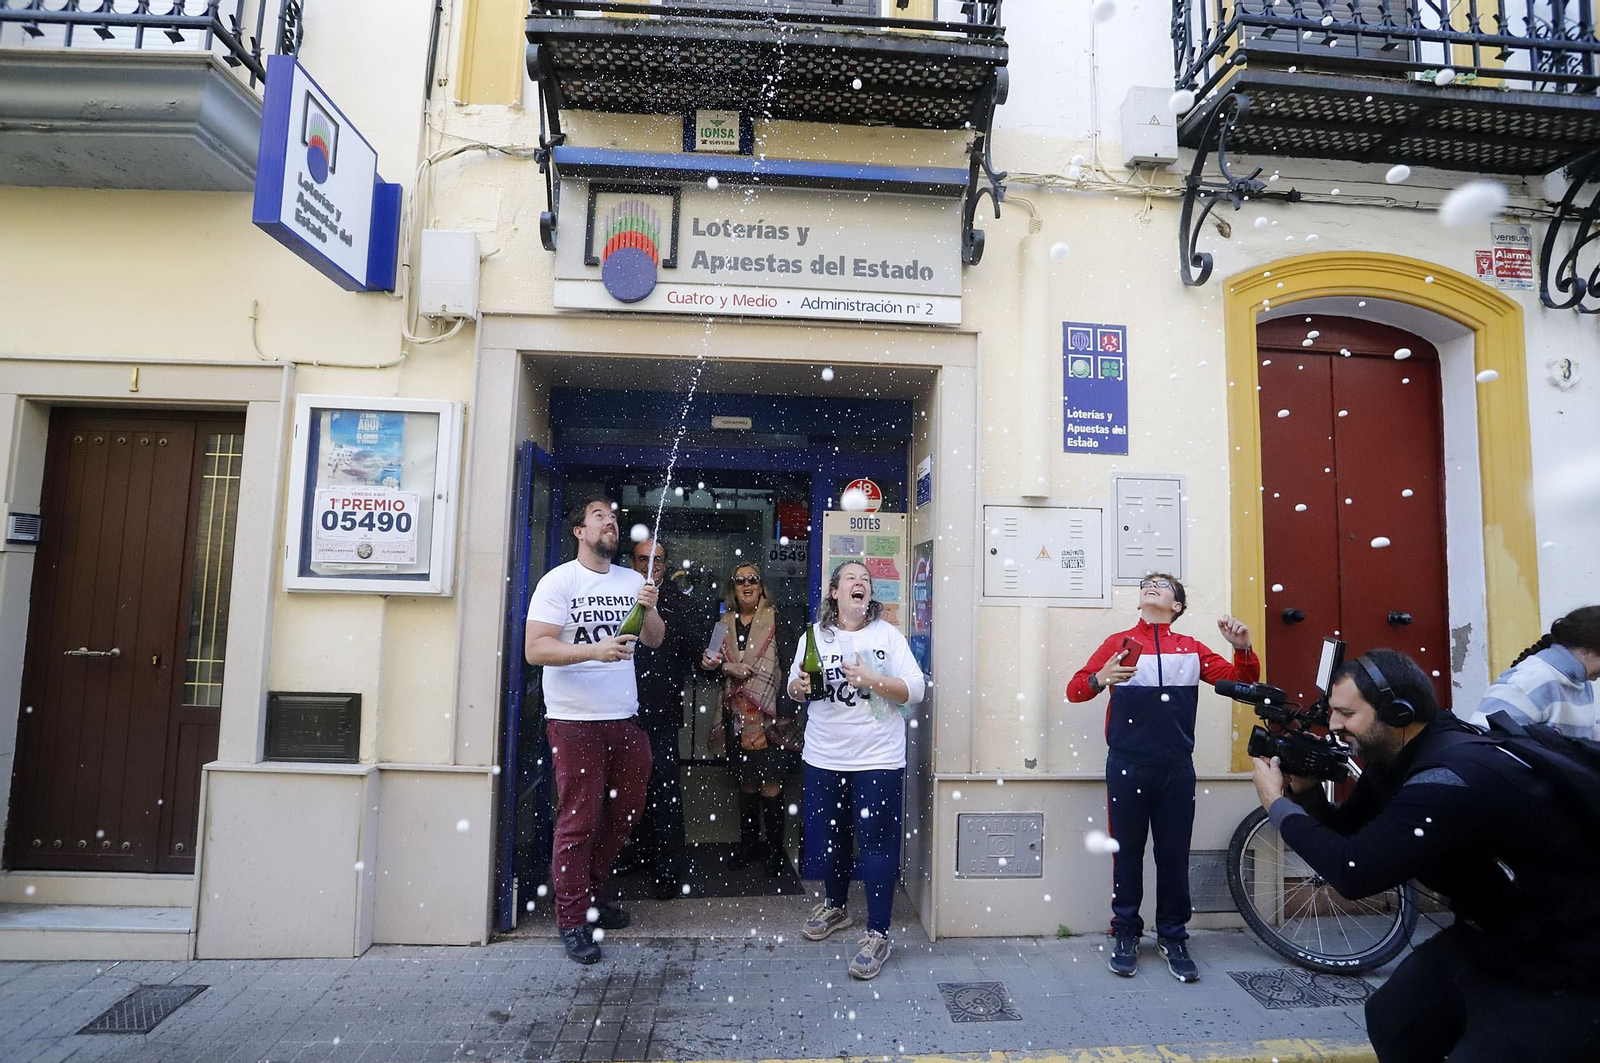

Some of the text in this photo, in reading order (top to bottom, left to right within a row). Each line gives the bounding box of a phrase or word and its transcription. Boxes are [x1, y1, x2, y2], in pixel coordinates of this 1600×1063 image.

[298, 171, 342, 223] Loterías y
[295, 207, 327, 243] Estado
[296, 191, 353, 247] Apuestas del
[692, 217, 810, 246] Loterías y
[1494, 234, 1530, 243] verisure
[1495, 250, 1531, 261] Alarma
[691, 249, 934, 282] Apuestas del Estado
[667, 290, 715, 306] Cuatro
[719, 295, 729, 309] y
[732, 293, 778, 309] Medio
[800, 296, 903, 314] Administración
[925, 303, 934, 316] 2
[1066, 408, 1113, 422] Loterías y
[1066, 423, 1127, 435] Apuestas del
[1067, 437, 1099, 449] Estado
[341, 498, 406, 512] PREMIO
[321, 510, 412, 534] 05490
[850, 517, 881, 531] BOTES
[966, 819, 1037, 832] CONTADOR
[1297, 950, 1360, 967] MAXXIS
